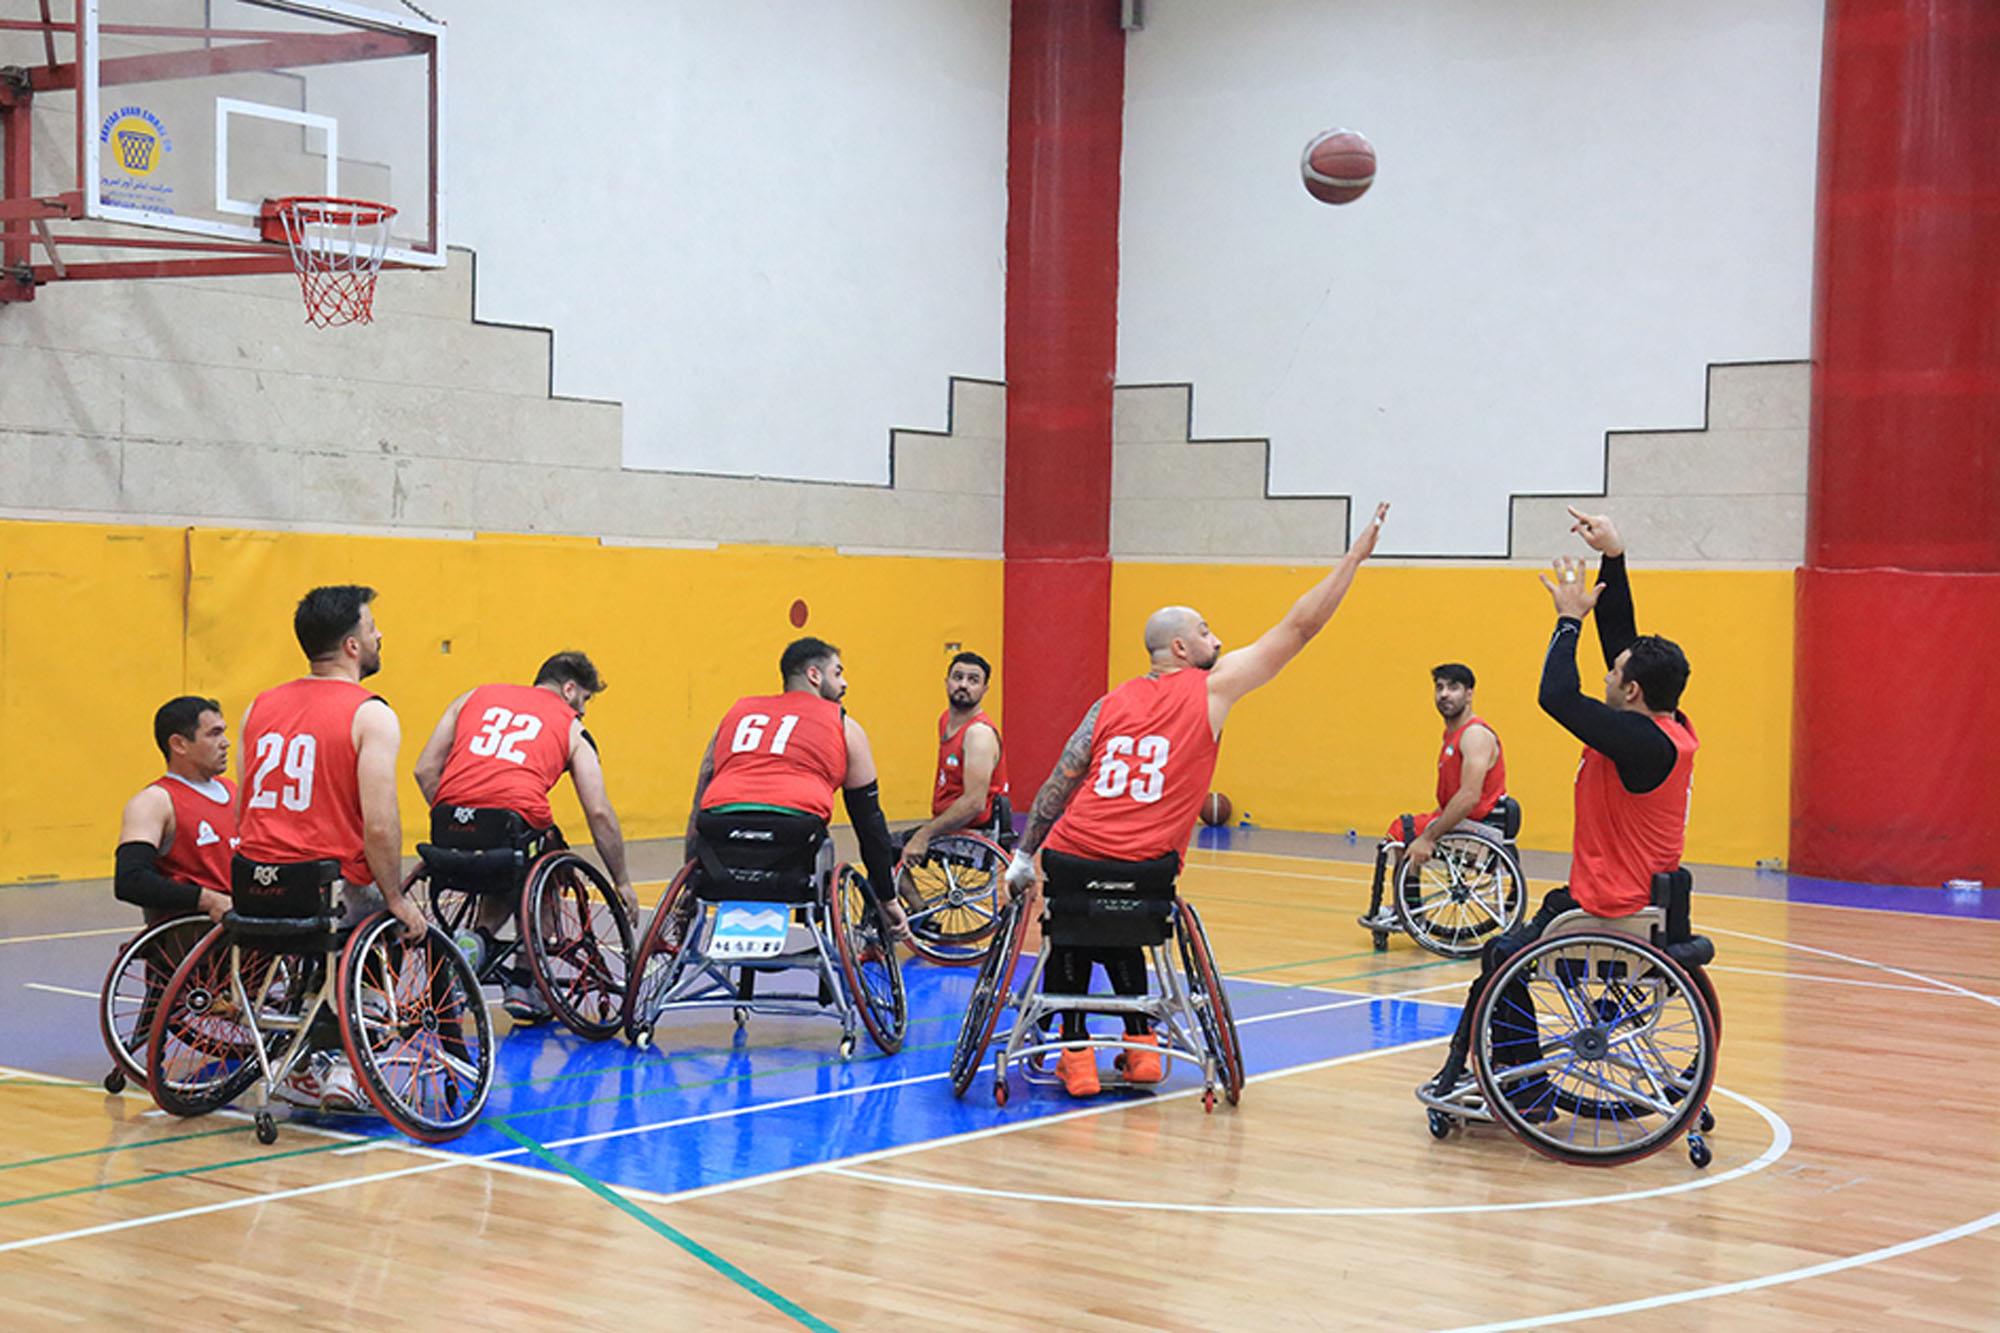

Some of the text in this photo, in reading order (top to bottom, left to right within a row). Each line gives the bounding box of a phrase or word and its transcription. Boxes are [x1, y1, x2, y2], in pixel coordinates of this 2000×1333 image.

[469, 706, 543, 764] 32
[731, 713, 800, 754] 61
[249, 733, 316, 811] 29
[1094, 735, 1170, 802] 63
